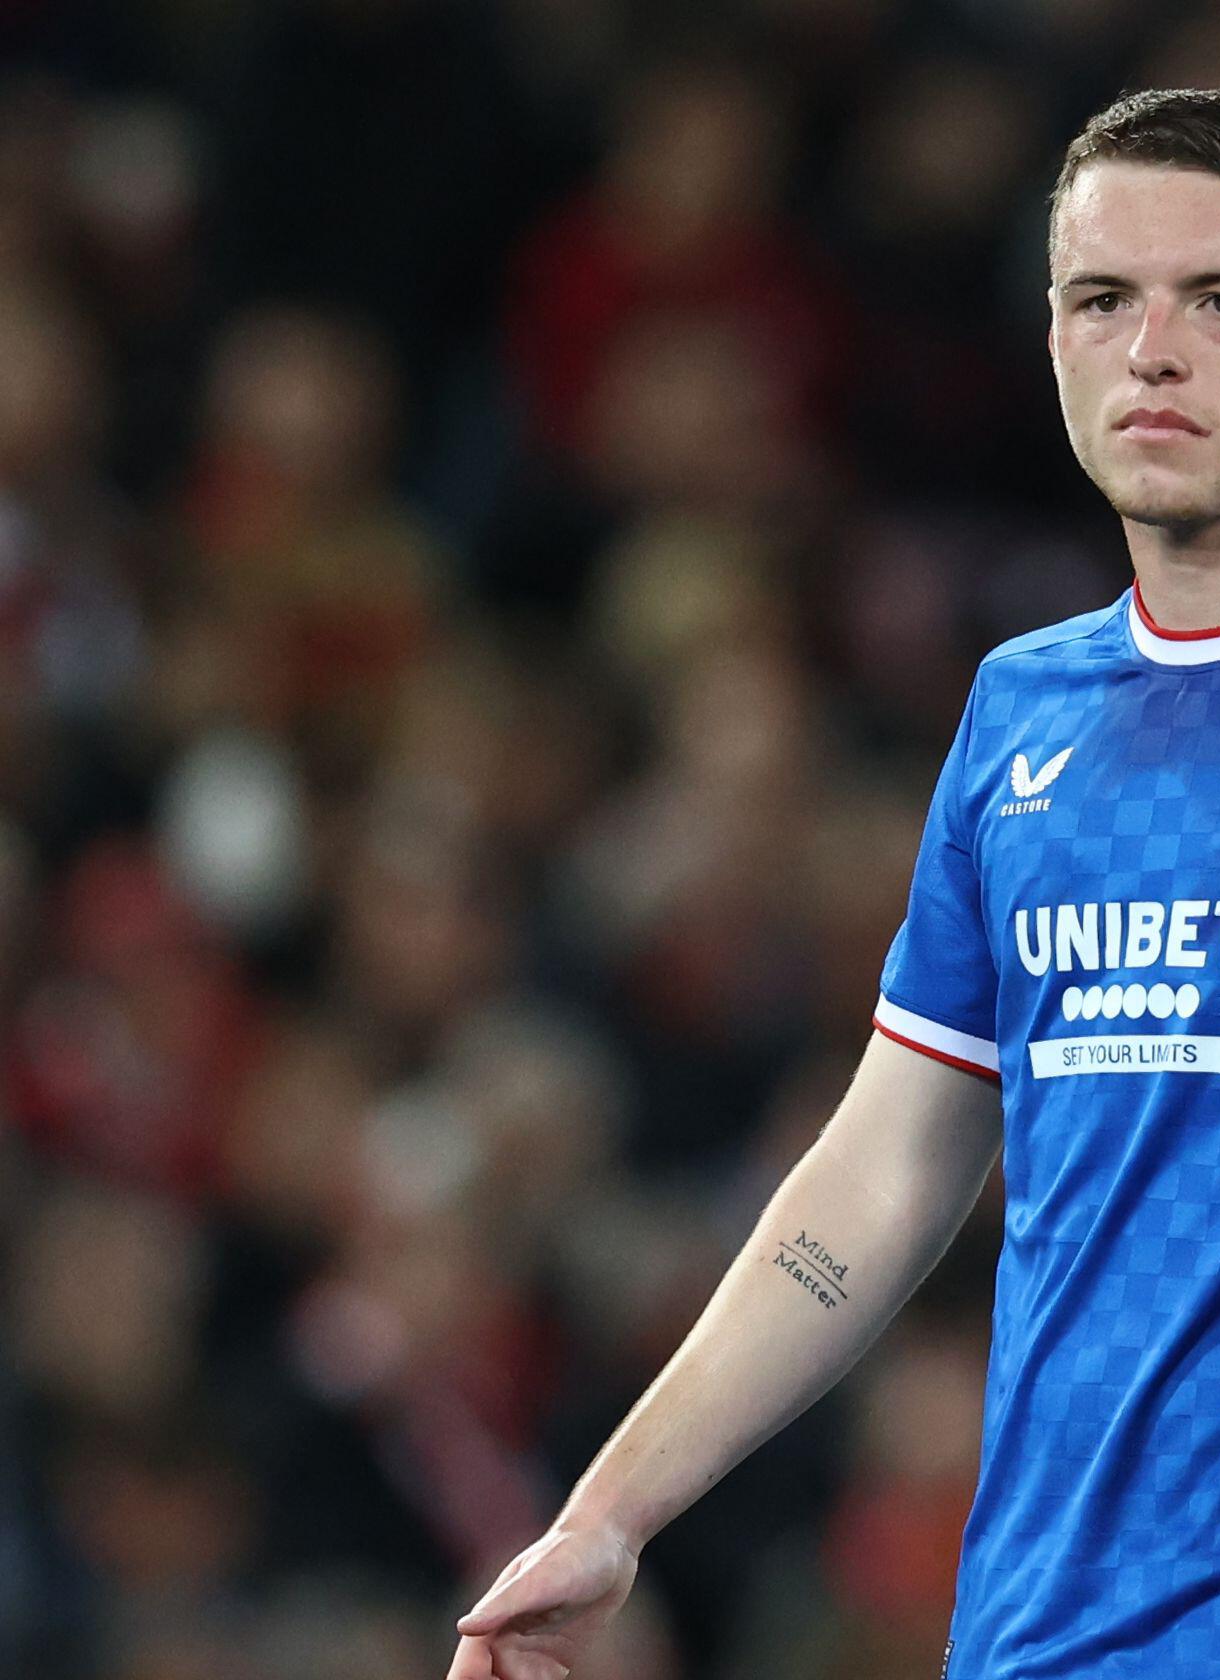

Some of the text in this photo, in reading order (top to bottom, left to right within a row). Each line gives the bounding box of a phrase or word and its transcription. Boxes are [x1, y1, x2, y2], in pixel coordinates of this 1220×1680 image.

[1000, 798, 1051, 817] CASTORE
[1063, 1044, 1197, 1066] SET YOUR LIMTS
[795, 1230, 849, 1282] Mind
[773, 1251, 837, 1309] Matter
